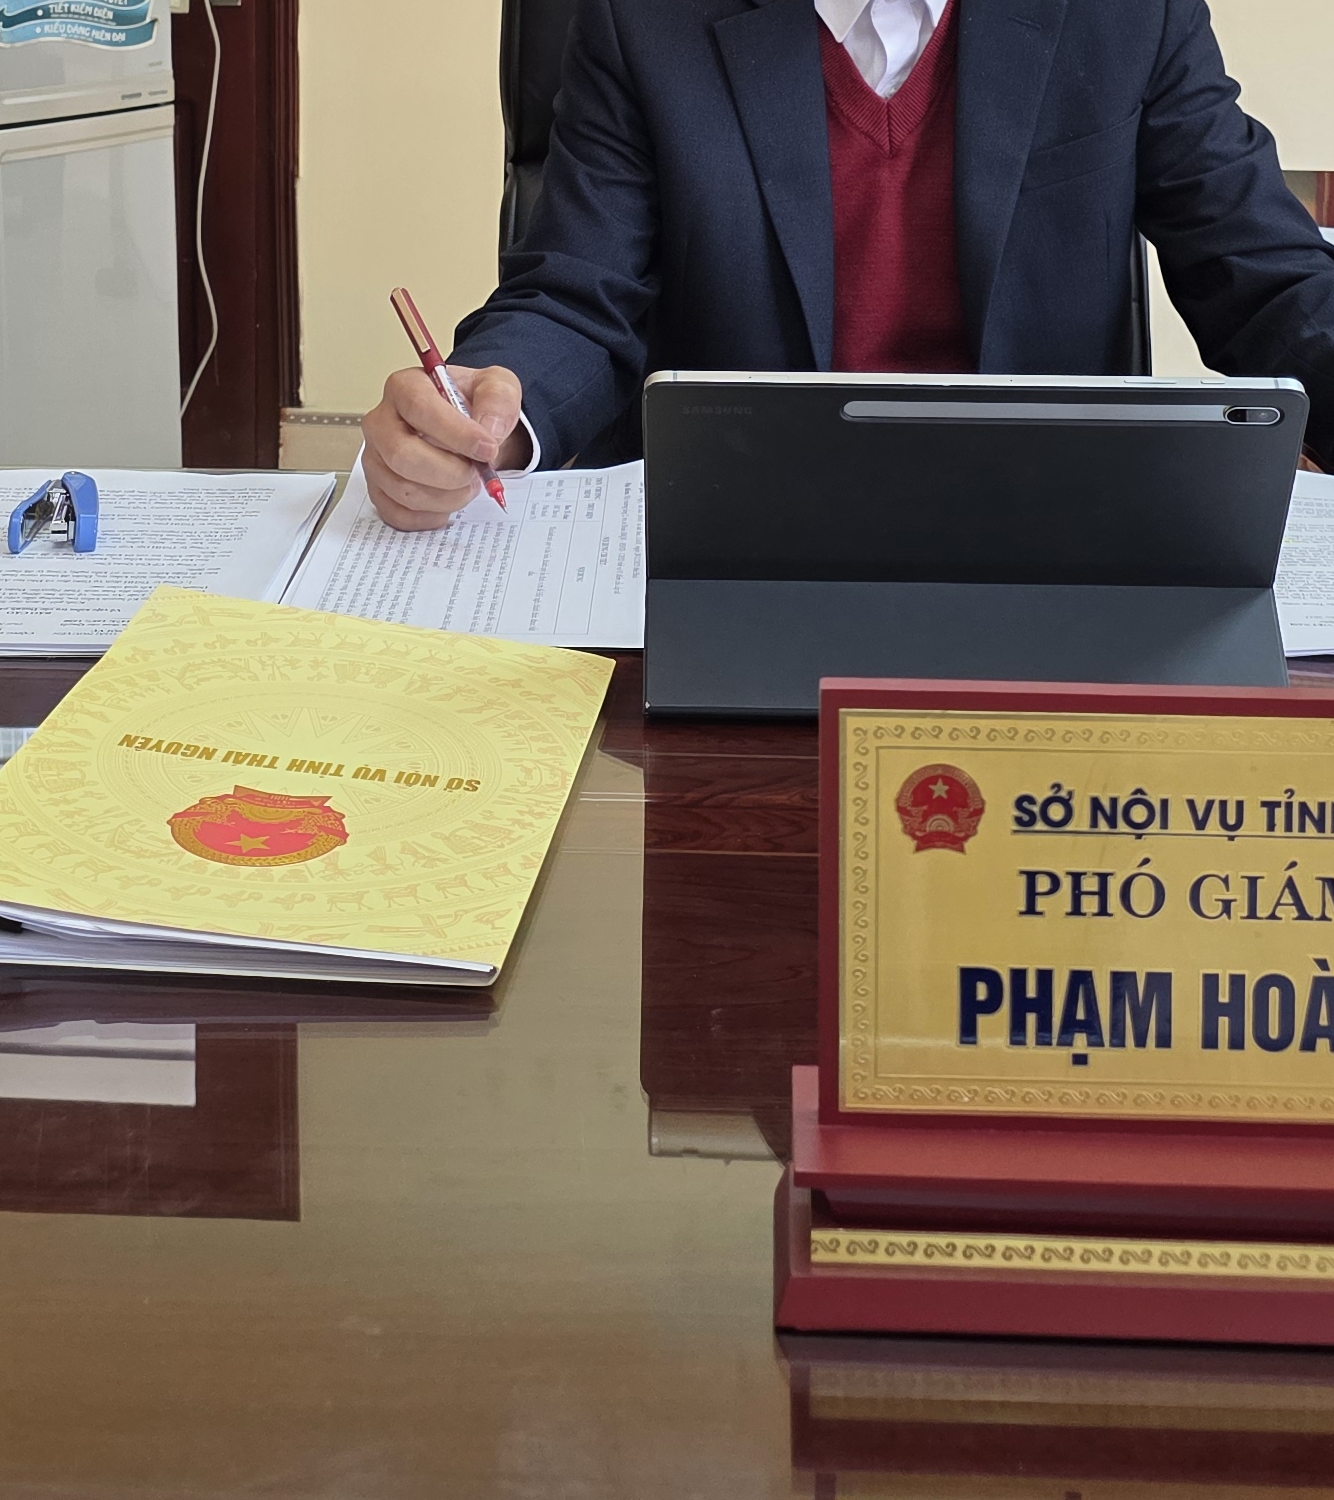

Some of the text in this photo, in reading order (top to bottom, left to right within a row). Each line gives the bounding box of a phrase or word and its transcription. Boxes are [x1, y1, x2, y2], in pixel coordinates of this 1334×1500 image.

[117, 733, 481, 793] SỞ NỘI VỤ TỈNH THÁI NGUYÊN
[1013, 782, 1074, 829] SỞ
[1089, 787, 1169, 840] NỘI
[1186, 798, 1245, 842] VỤ
[1018, 856, 1166, 919] PHÓ
[958, 966, 1173, 1066] PHẠM
